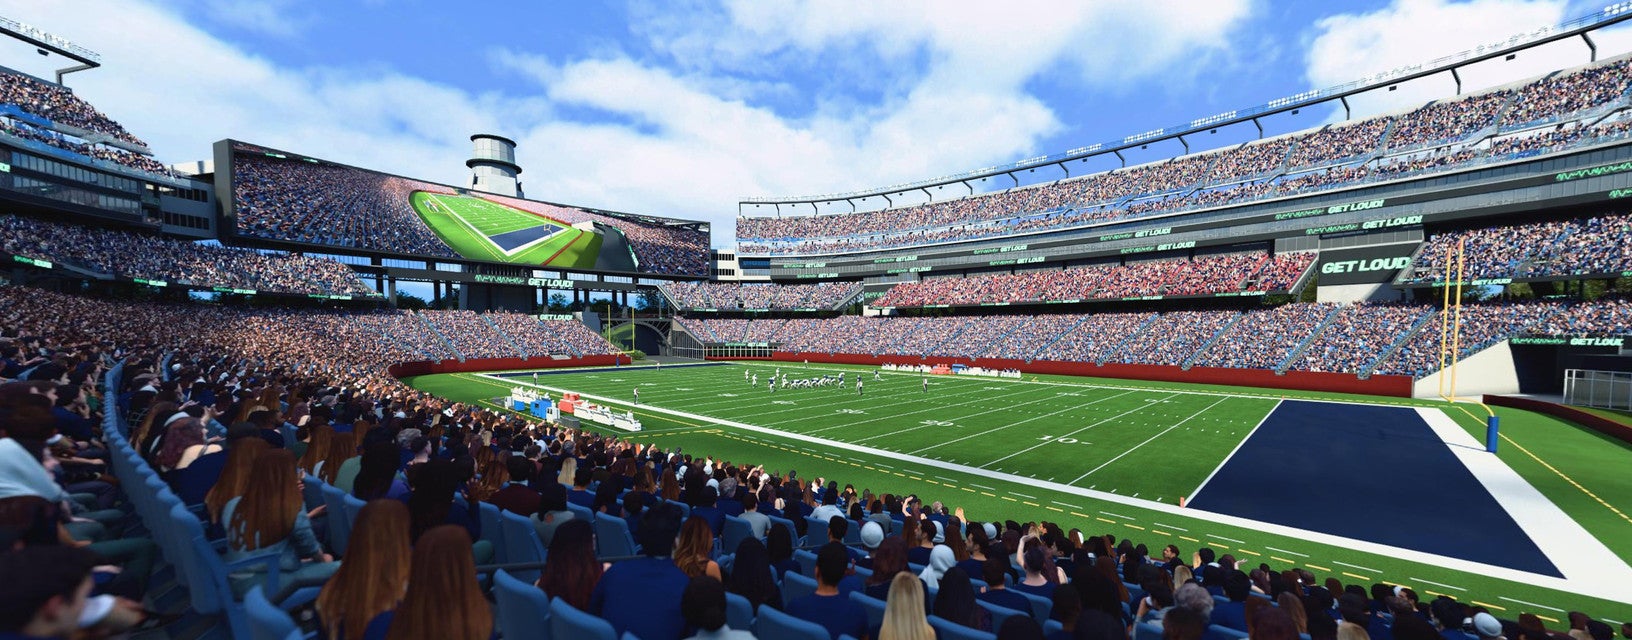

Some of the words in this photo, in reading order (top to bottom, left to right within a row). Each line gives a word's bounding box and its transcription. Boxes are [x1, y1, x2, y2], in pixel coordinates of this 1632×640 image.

[1328, 205, 1350, 214] GET
[1350, 200, 1384, 210] LOUD!
[1362, 219, 1386, 229] GET
[1386, 216, 1422, 226] LOUD!
[1322, 262, 1358, 274] GET
[528, 278, 548, 286] GET
[547, 279, 574, 288] LOUD!
[1570, 338, 1595, 346] GET
[1036, 434, 1078, 444] 10
